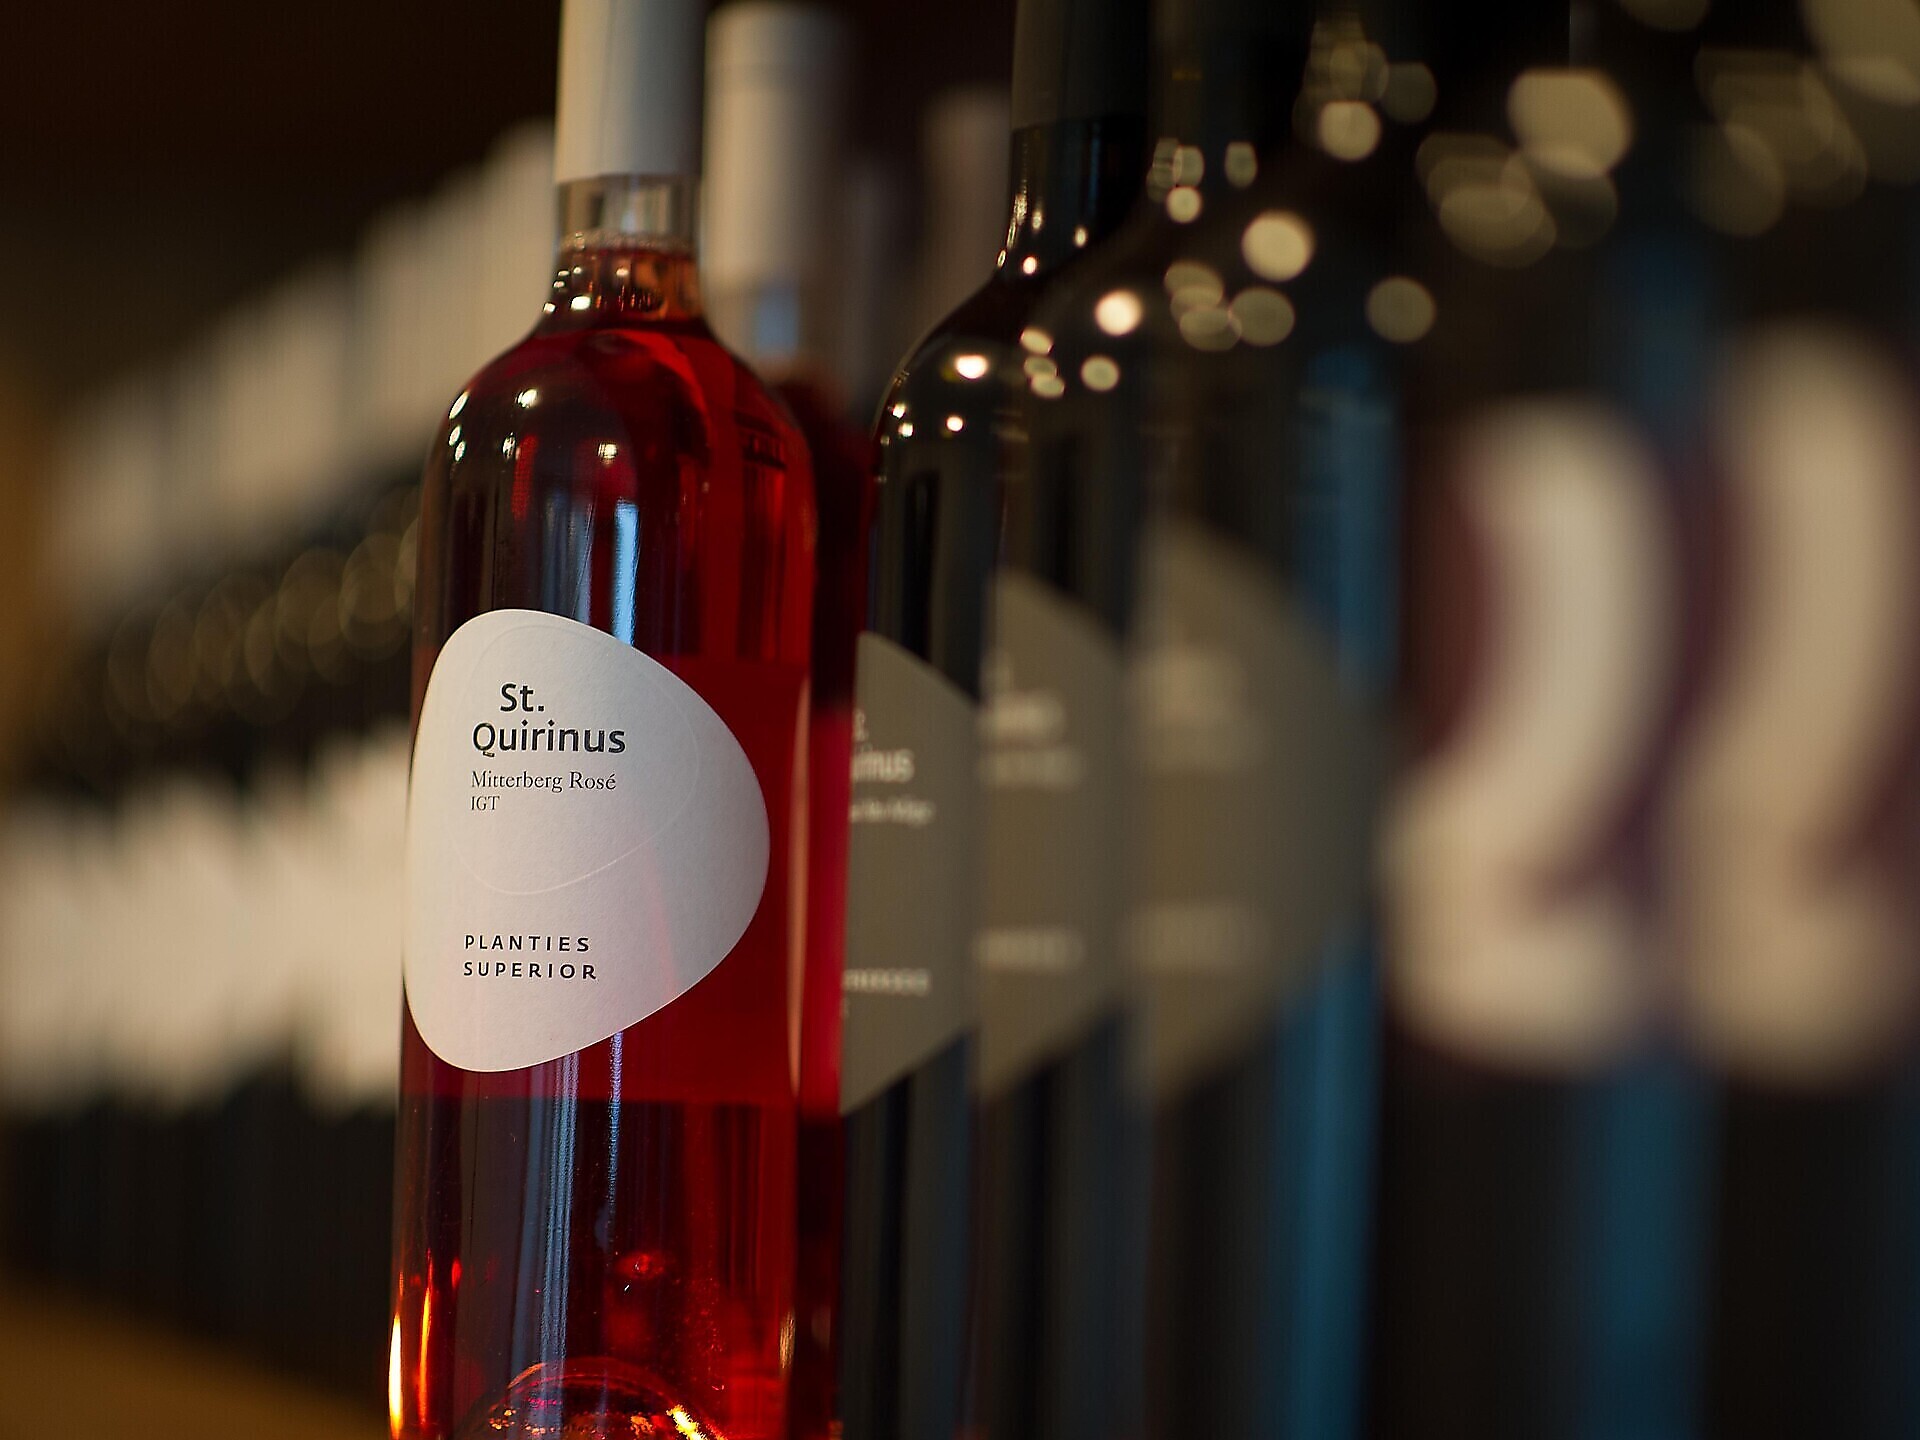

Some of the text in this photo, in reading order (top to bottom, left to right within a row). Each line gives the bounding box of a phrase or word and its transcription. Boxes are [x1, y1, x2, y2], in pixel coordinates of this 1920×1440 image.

[499, 682, 545, 713] St.
[472, 719, 626, 757] Quirinus
[471, 770, 617, 793] Mitterberg Rosé
[471, 795, 500, 811] IGT
[464, 934, 590, 953] PLANTIES
[463, 962, 597, 981] SUPERIOR
